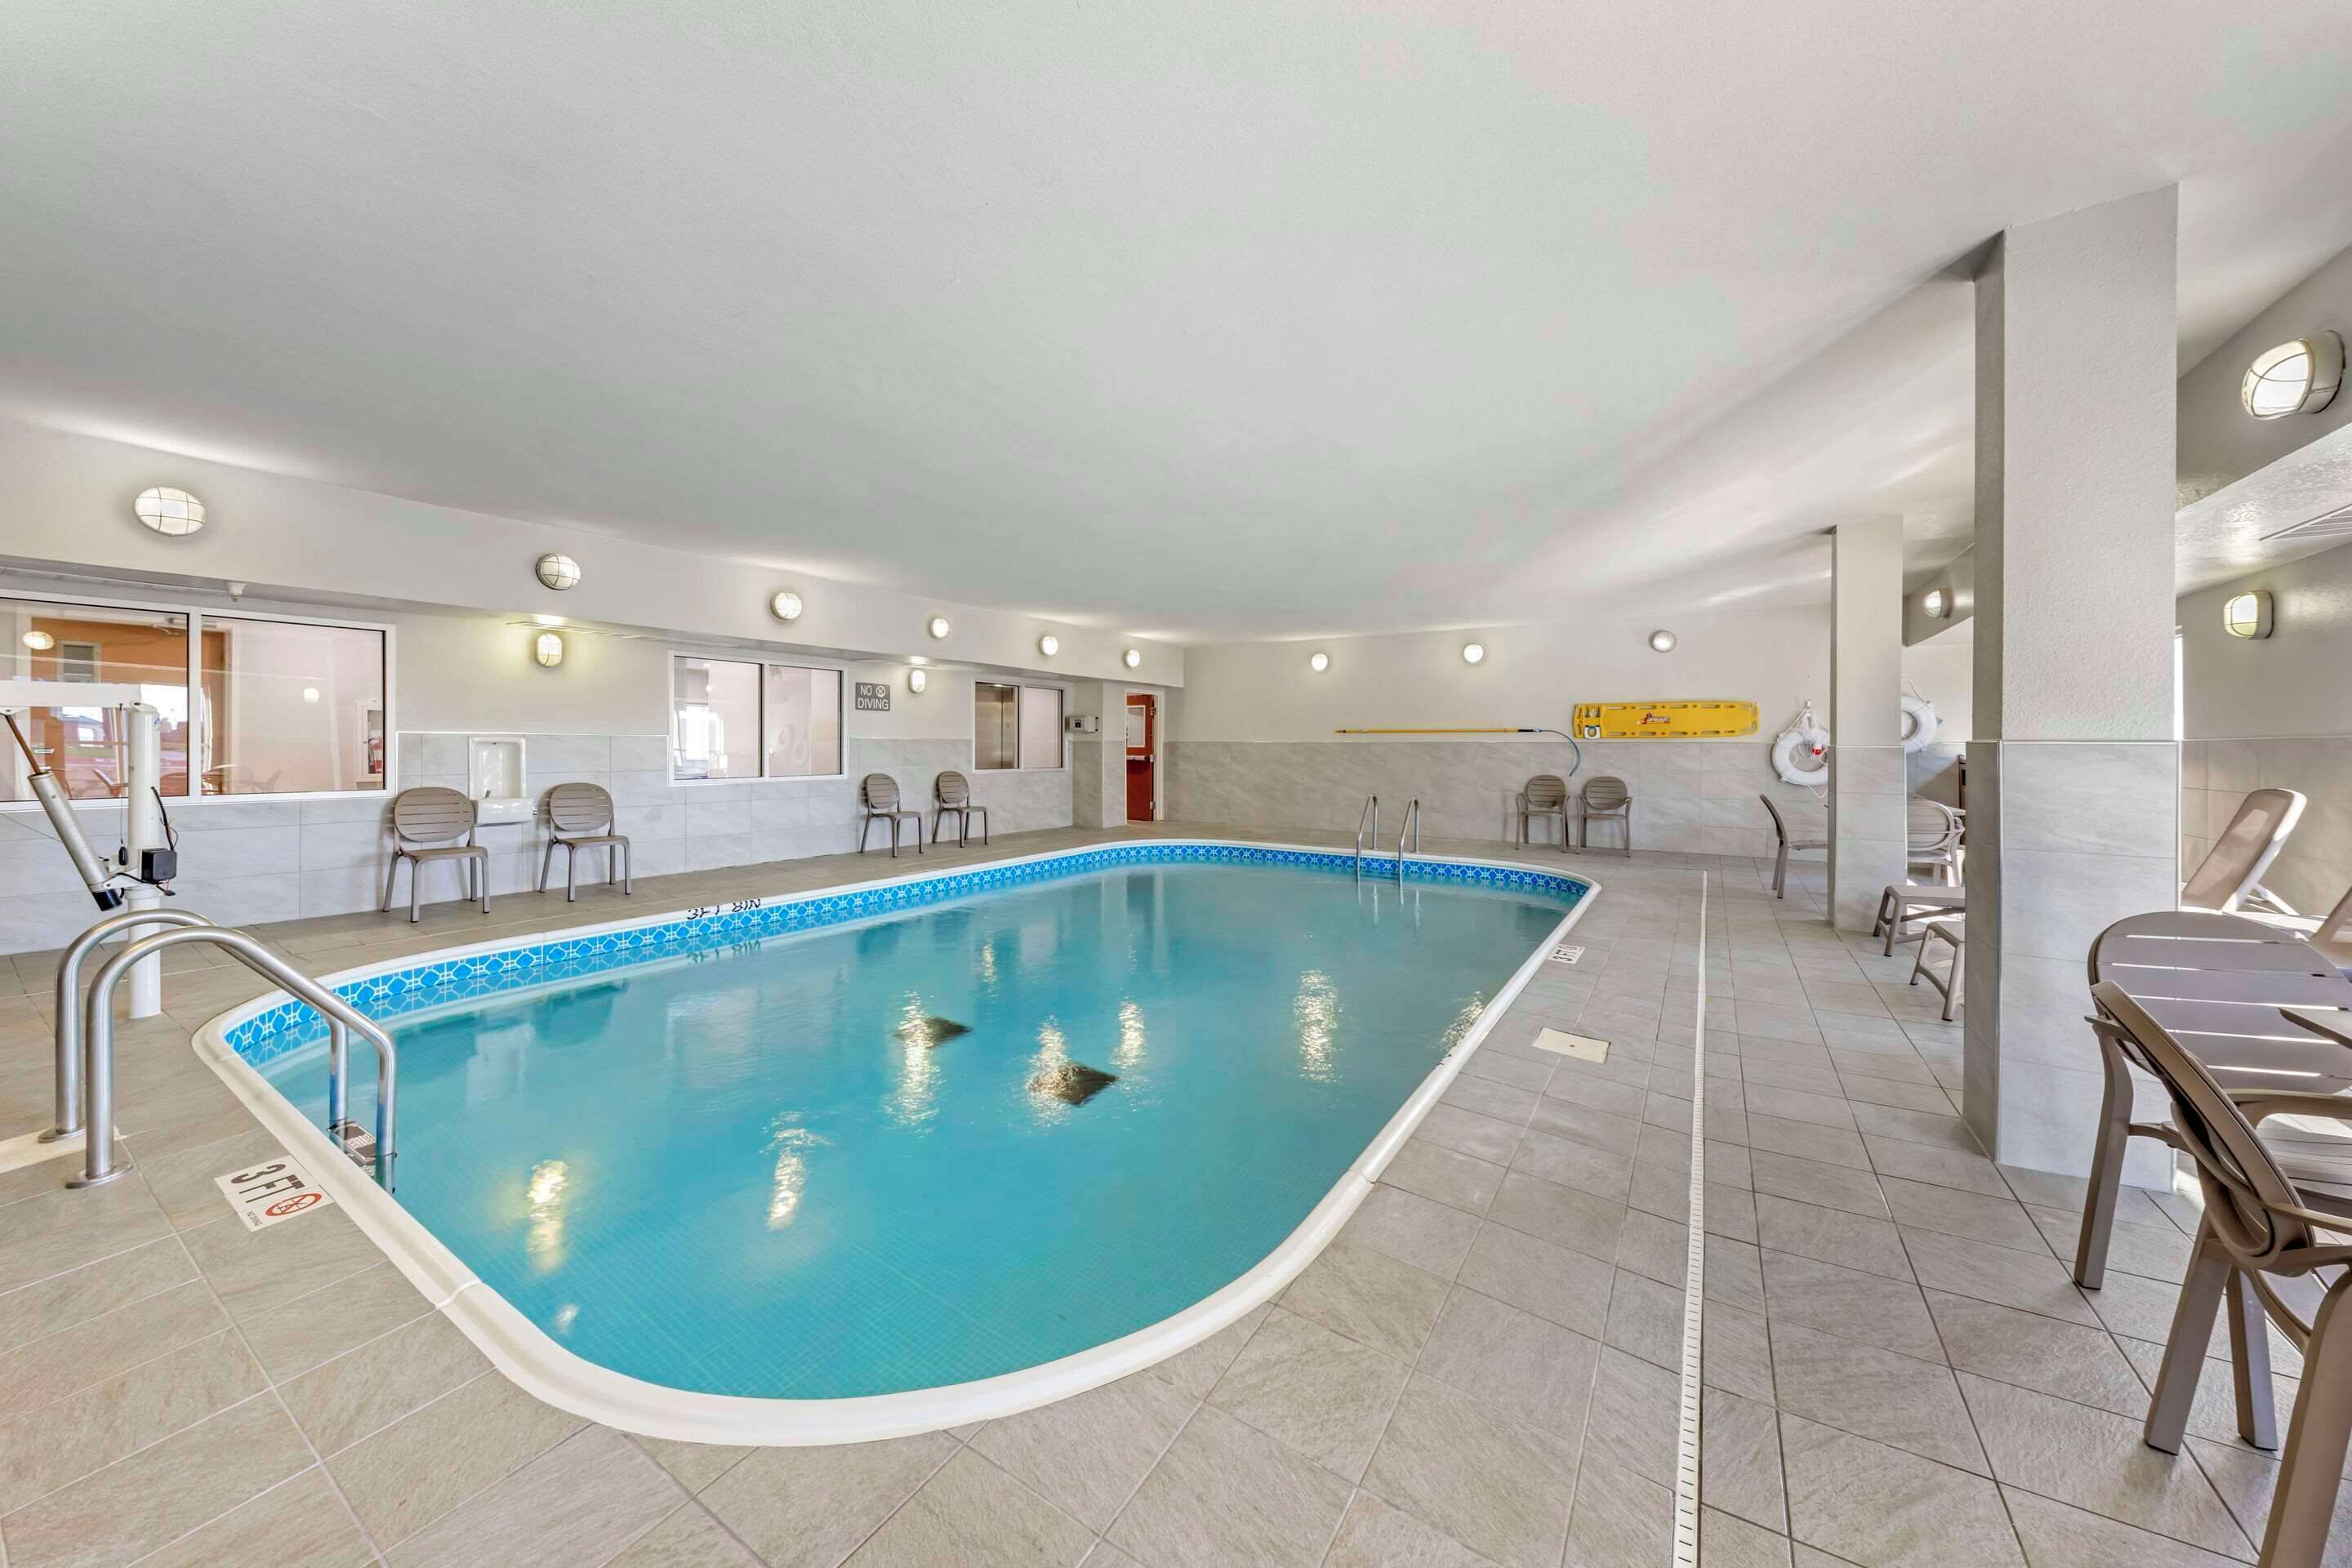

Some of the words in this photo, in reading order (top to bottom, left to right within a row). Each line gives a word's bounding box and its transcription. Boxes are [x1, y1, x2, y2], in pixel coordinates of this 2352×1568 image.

[860, 684, 873, 696] NO
[858, 697, 889, 710] DIVING
[731, 898, 761, 913] 8IN
